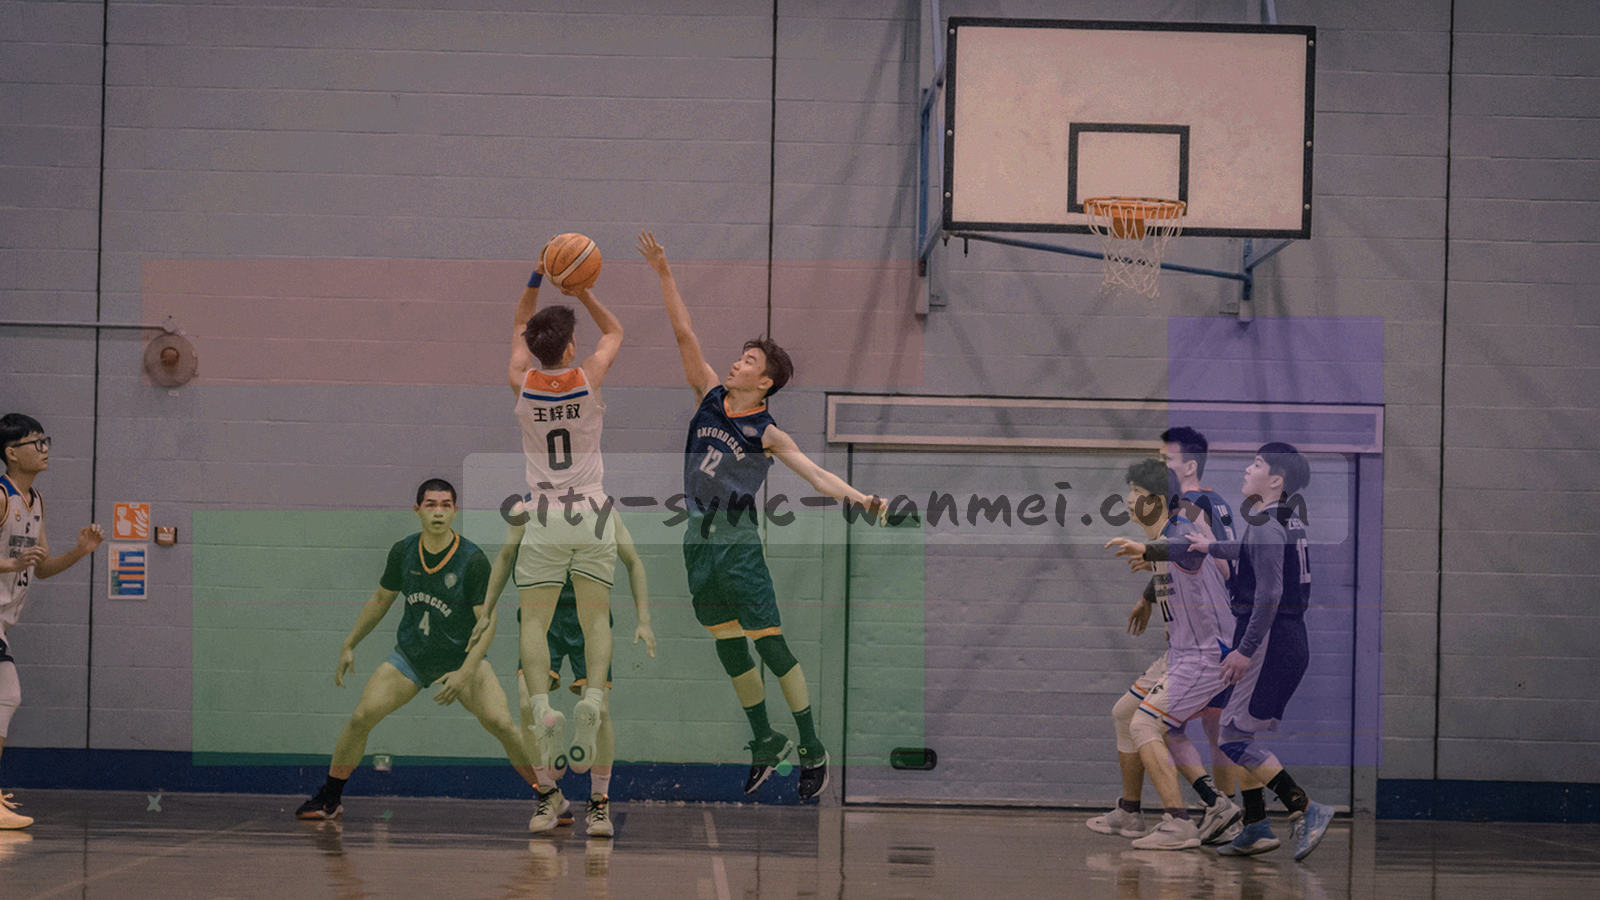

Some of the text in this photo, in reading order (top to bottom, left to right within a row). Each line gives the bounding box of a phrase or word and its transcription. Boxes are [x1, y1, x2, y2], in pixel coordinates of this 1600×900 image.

[546, 428, 573, 471] 0
[699, 444, 724, 478] 12
[418, 610, 431, 637] 4
